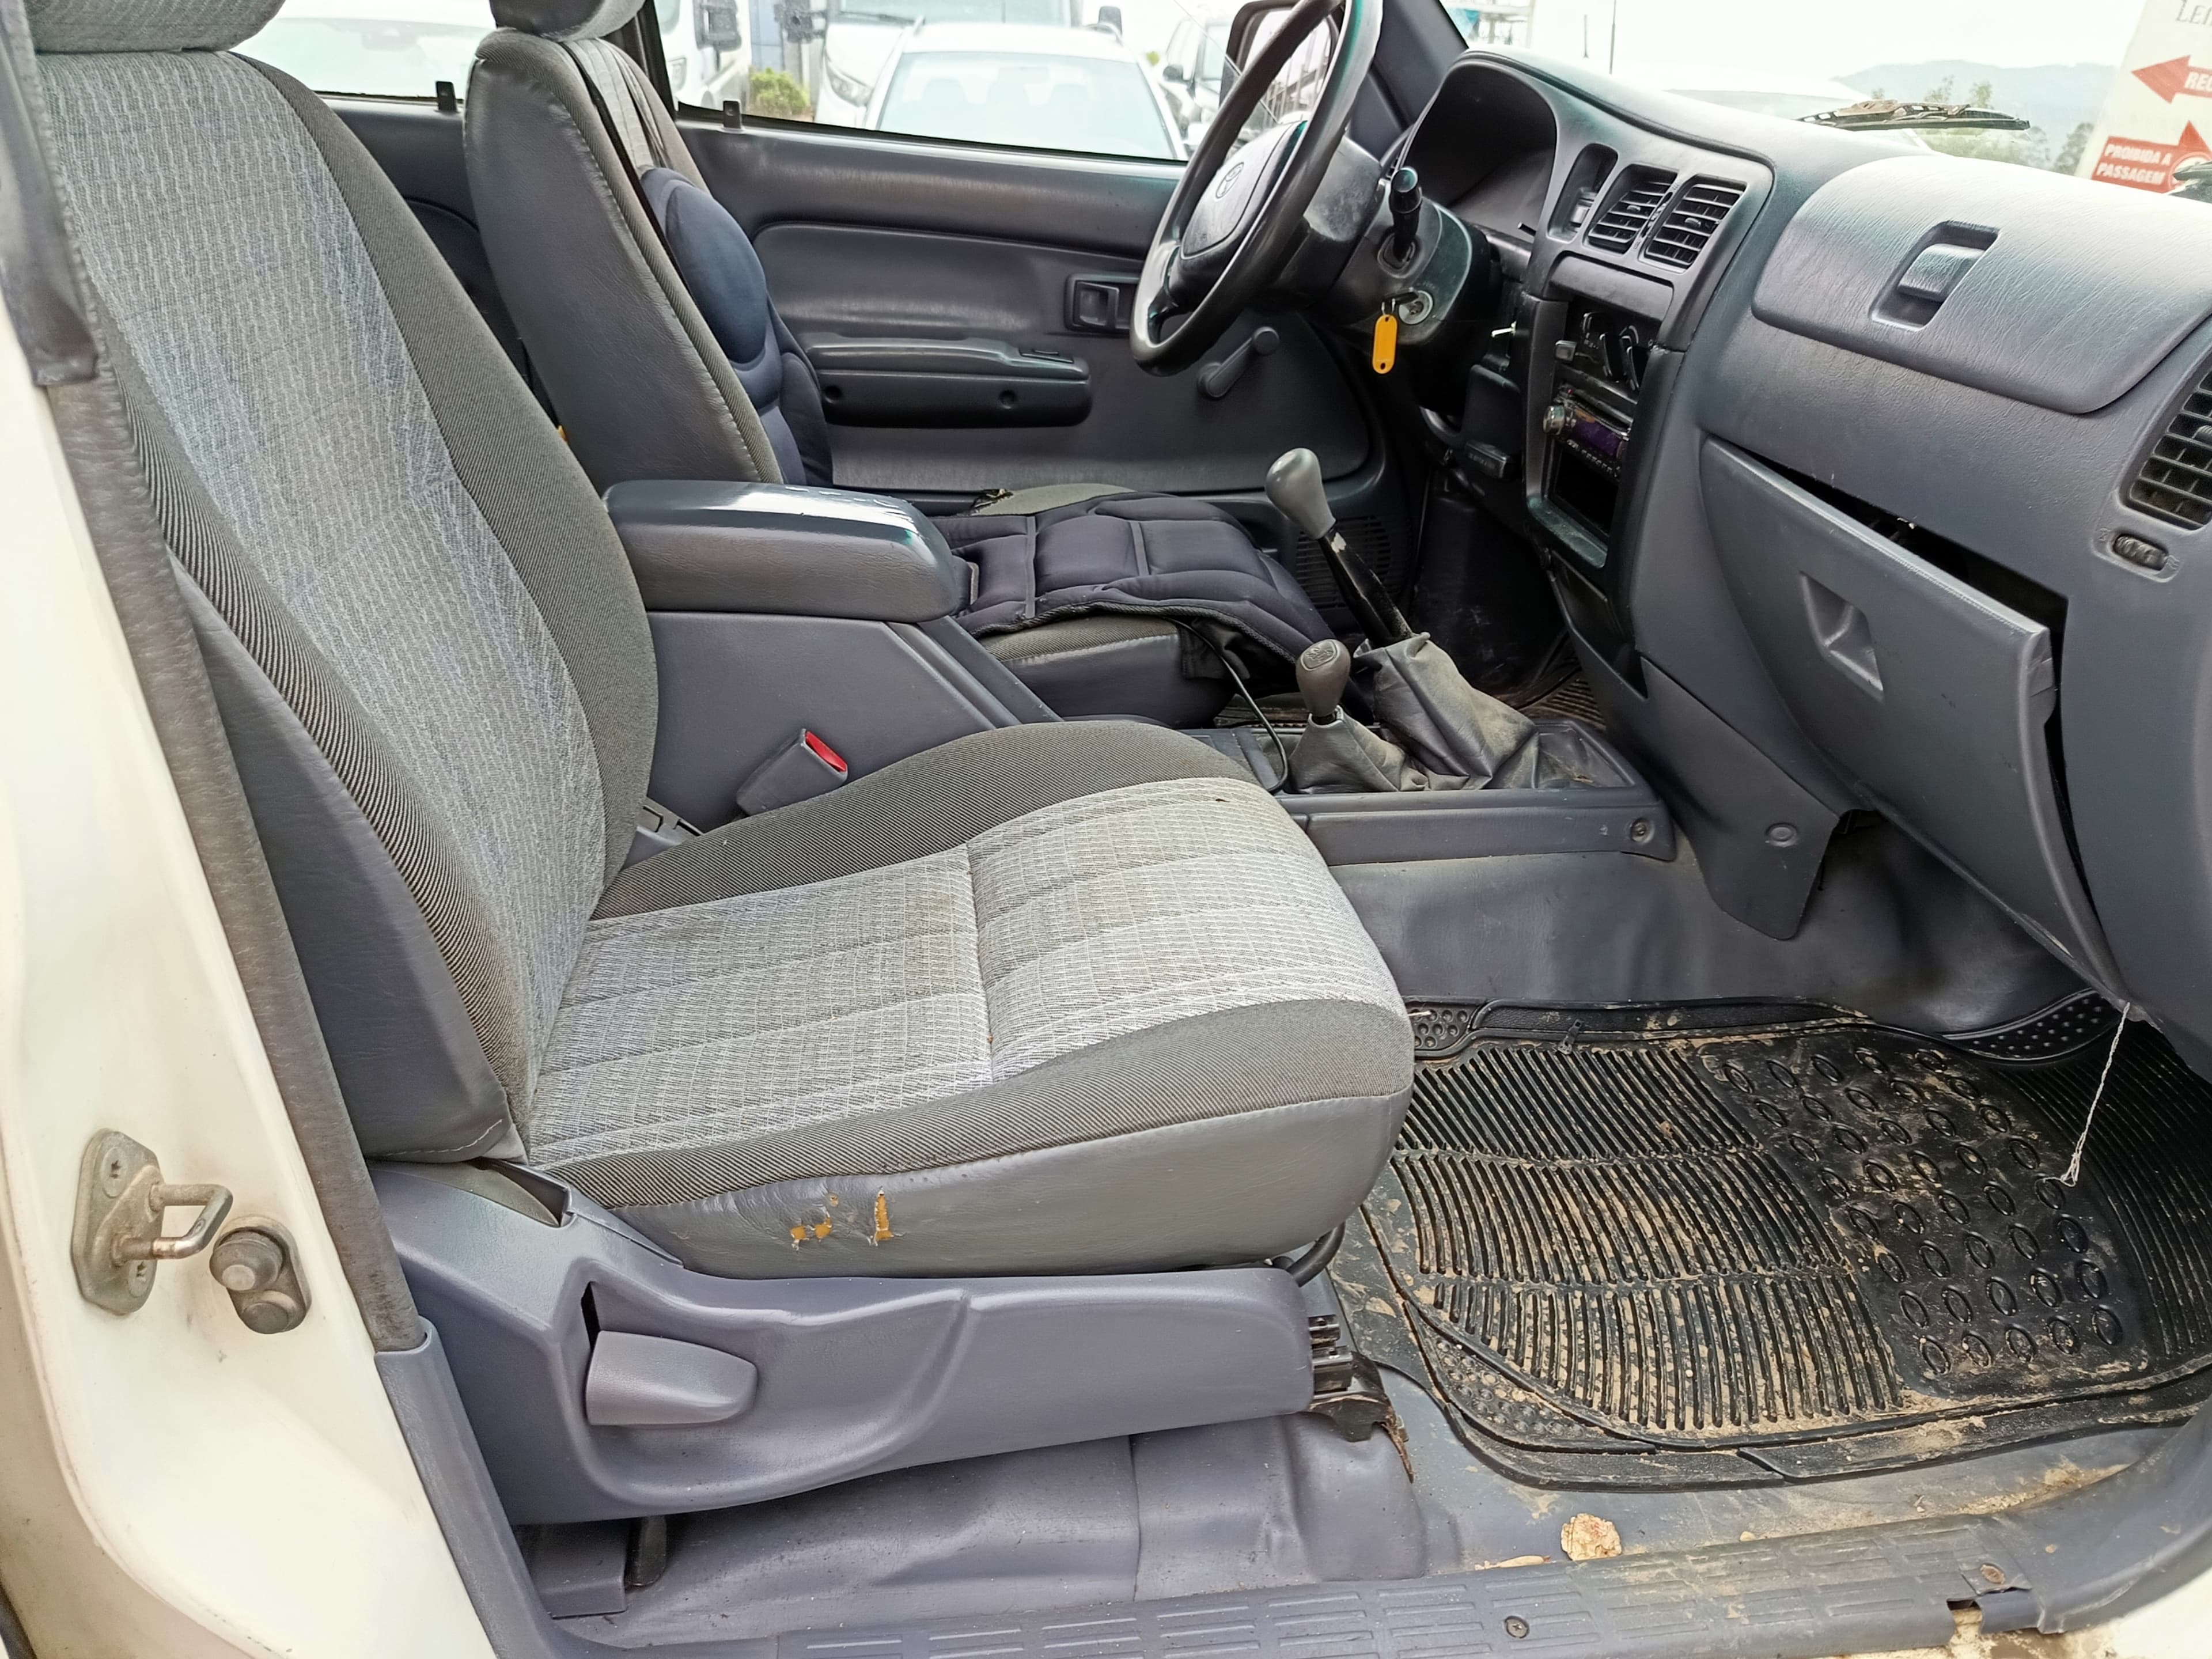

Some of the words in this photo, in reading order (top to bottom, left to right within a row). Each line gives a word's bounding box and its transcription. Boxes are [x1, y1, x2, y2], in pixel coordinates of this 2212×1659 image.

[2105, 144, 2161, 164] PROIBIDA
[2161, 152, 2172, 166] A
[2096, 162, 2166, 185] PASSAGEM
